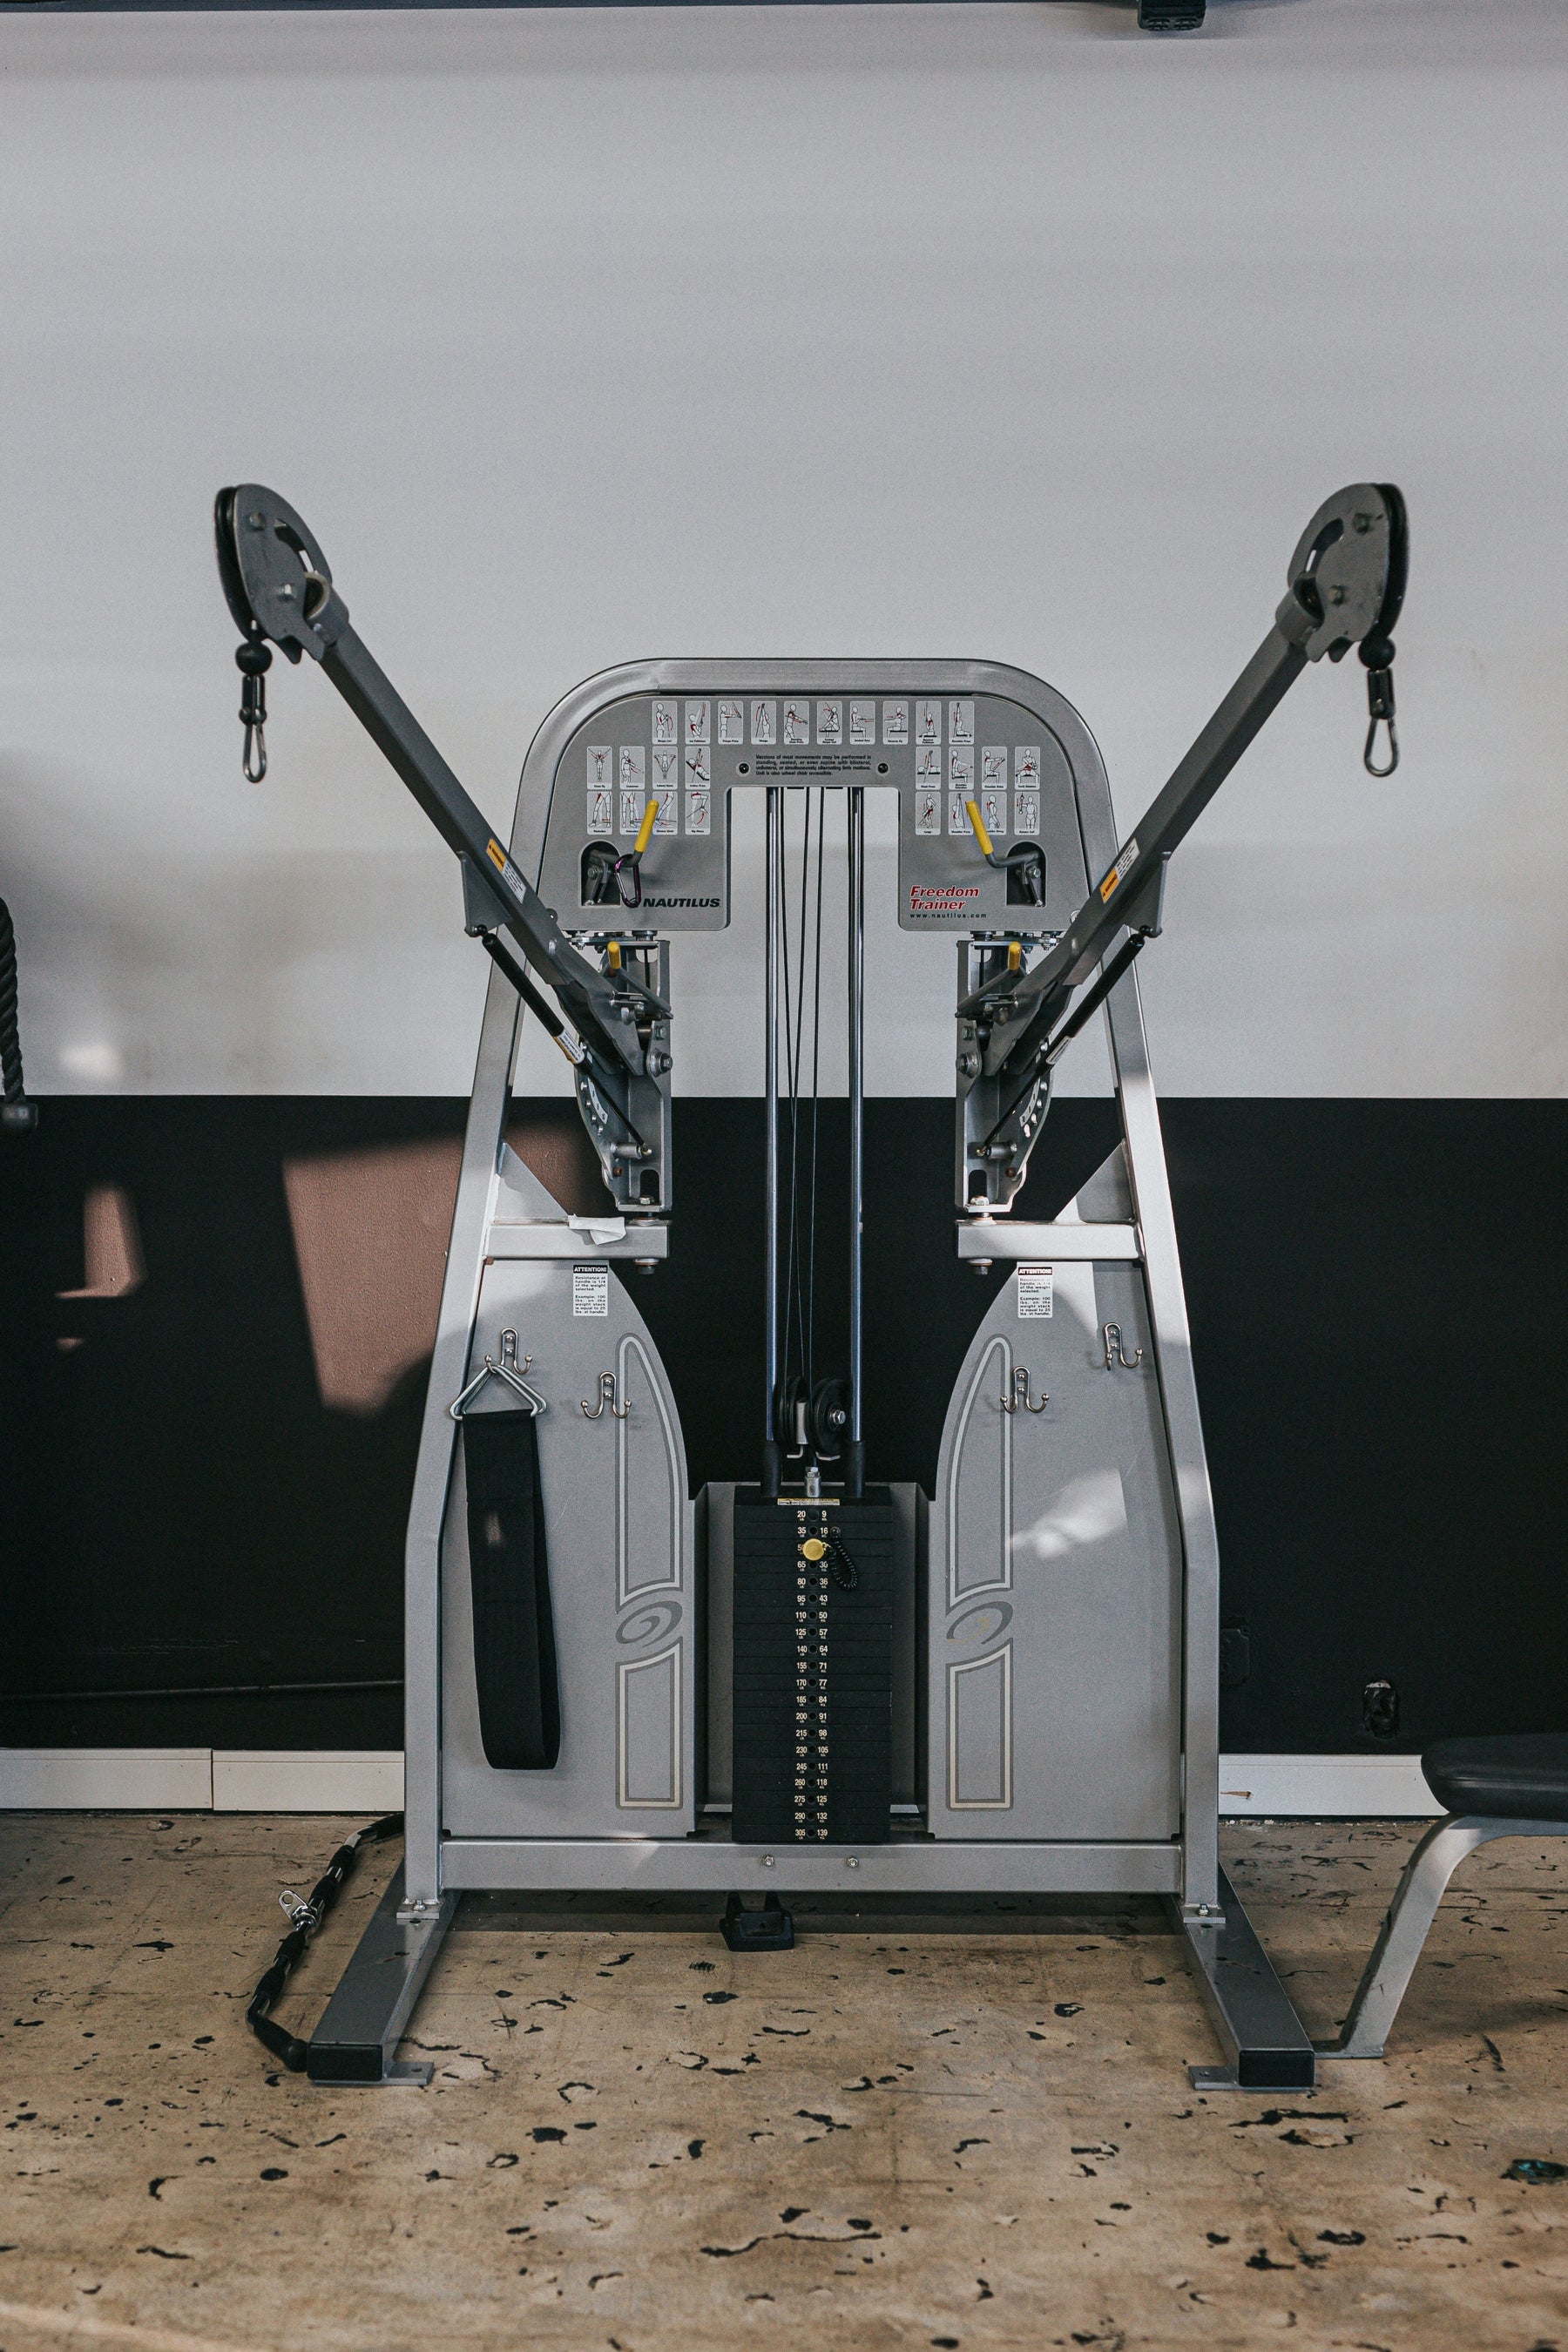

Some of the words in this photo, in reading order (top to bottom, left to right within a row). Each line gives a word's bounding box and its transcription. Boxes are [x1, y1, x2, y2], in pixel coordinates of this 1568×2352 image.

[910, 885, 979, 897] Freedom
[643, 898, 720, 908] NAUTILUS
[910, 898, 966, 910] Trainer
